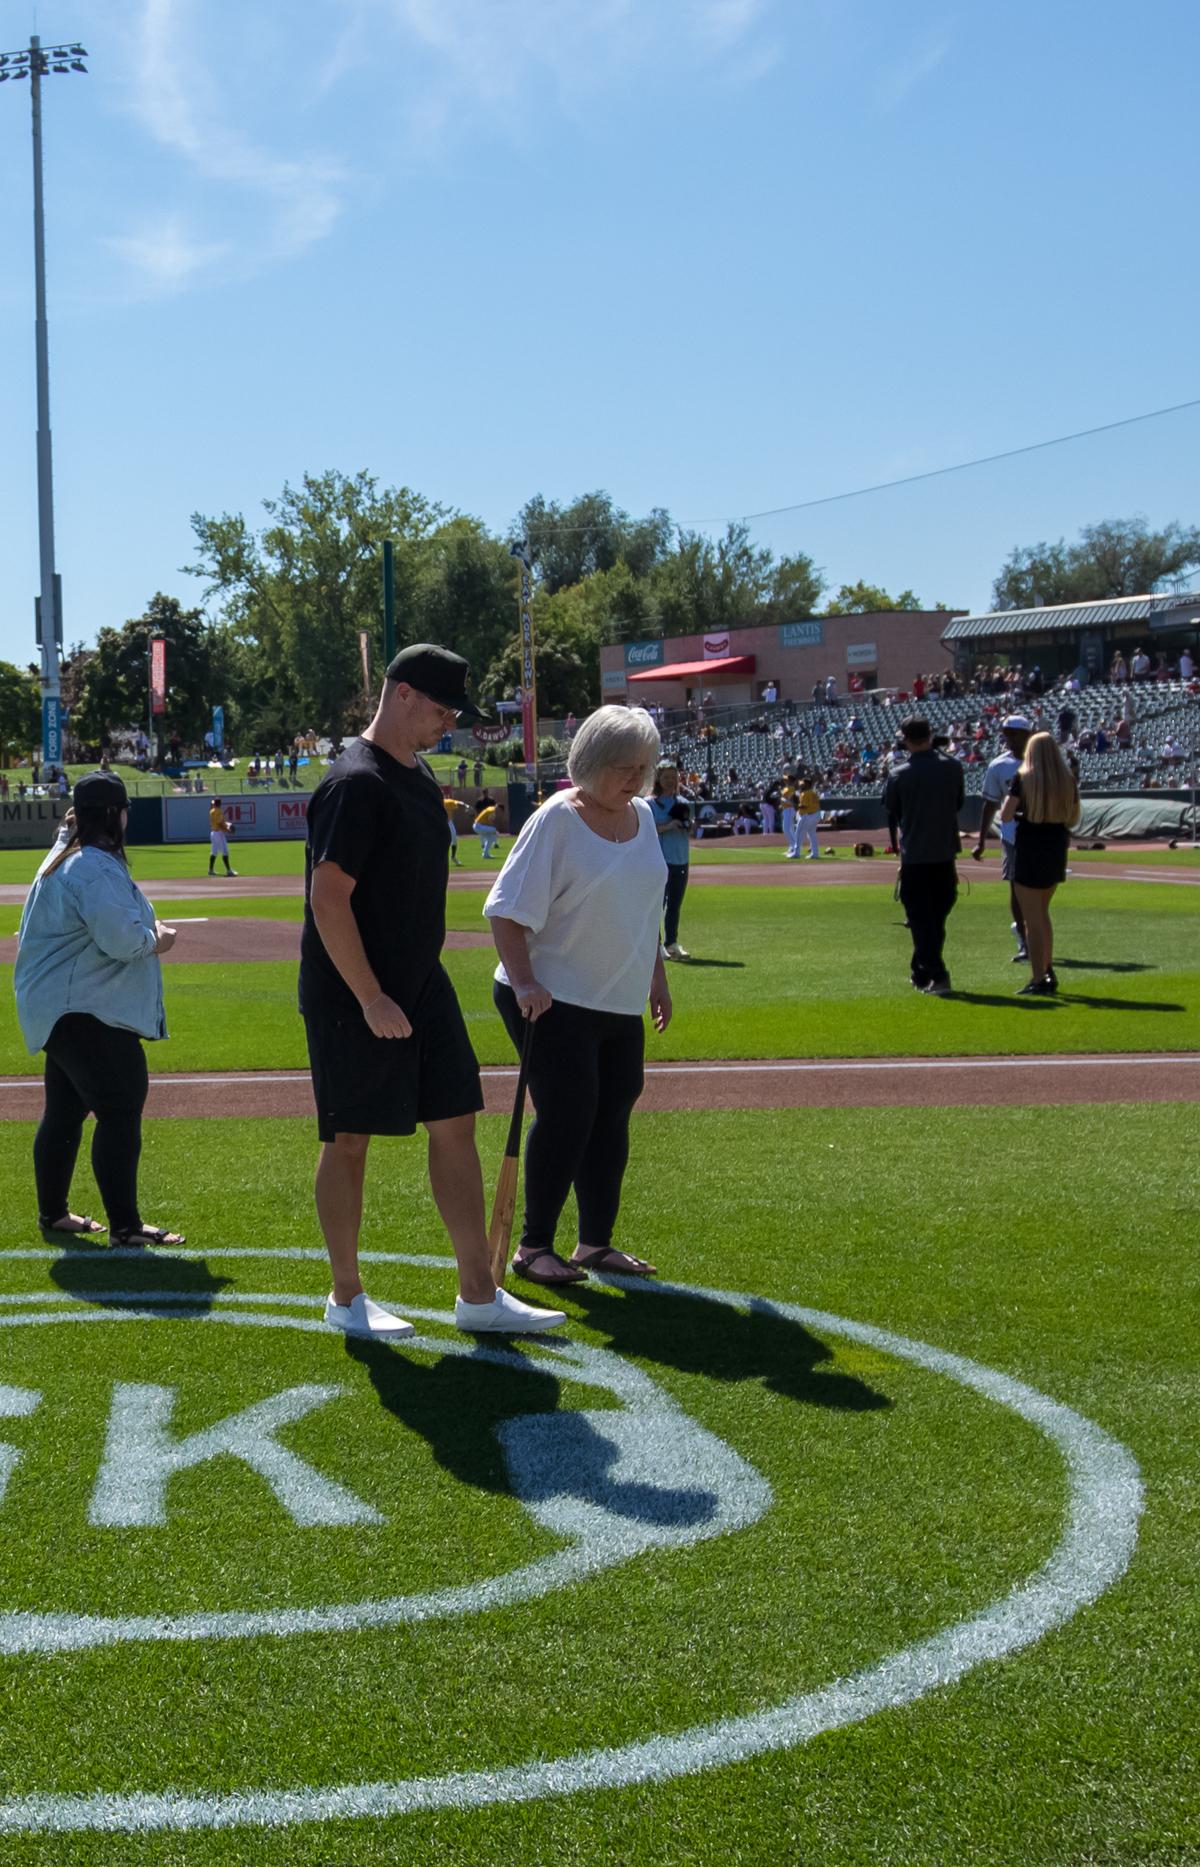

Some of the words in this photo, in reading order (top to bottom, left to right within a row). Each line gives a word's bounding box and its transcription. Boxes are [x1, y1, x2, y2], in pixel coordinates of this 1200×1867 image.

[522, 575, 530, 607] EAT
[522, 612, 531, 643] MOR
[783, 622, 820, 638] LANTIS
[524, 649, 533, 690] FOWL
[47, 701, 56, 728] ZONE
[48, 730, 57, 759] FORD
[286, 820, 308, 828] SERV
